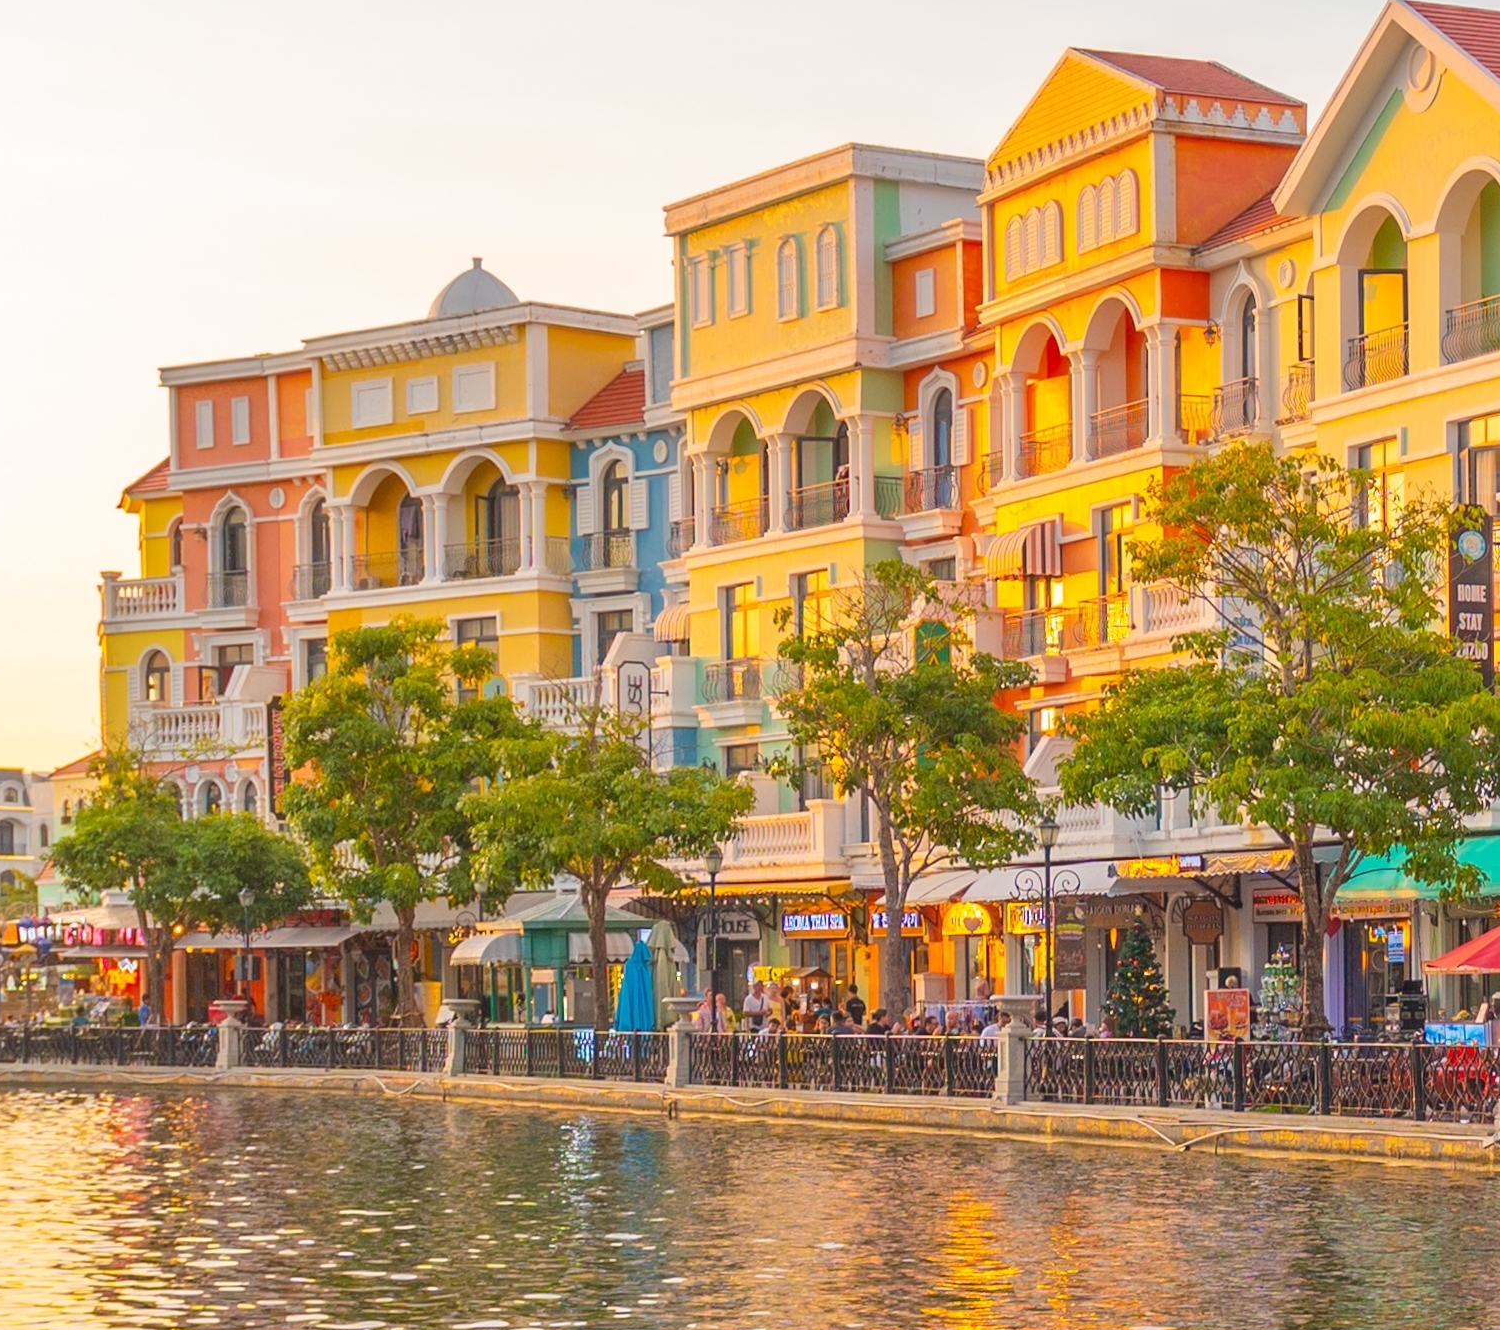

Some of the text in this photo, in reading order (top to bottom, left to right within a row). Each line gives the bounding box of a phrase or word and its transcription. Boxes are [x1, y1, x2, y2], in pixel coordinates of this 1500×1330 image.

[1457, 583, 1487, 603] HOME
[1458, 612, 1484, 632] STAY
[783, 913, 845, 932] AROMA THAI SPA
